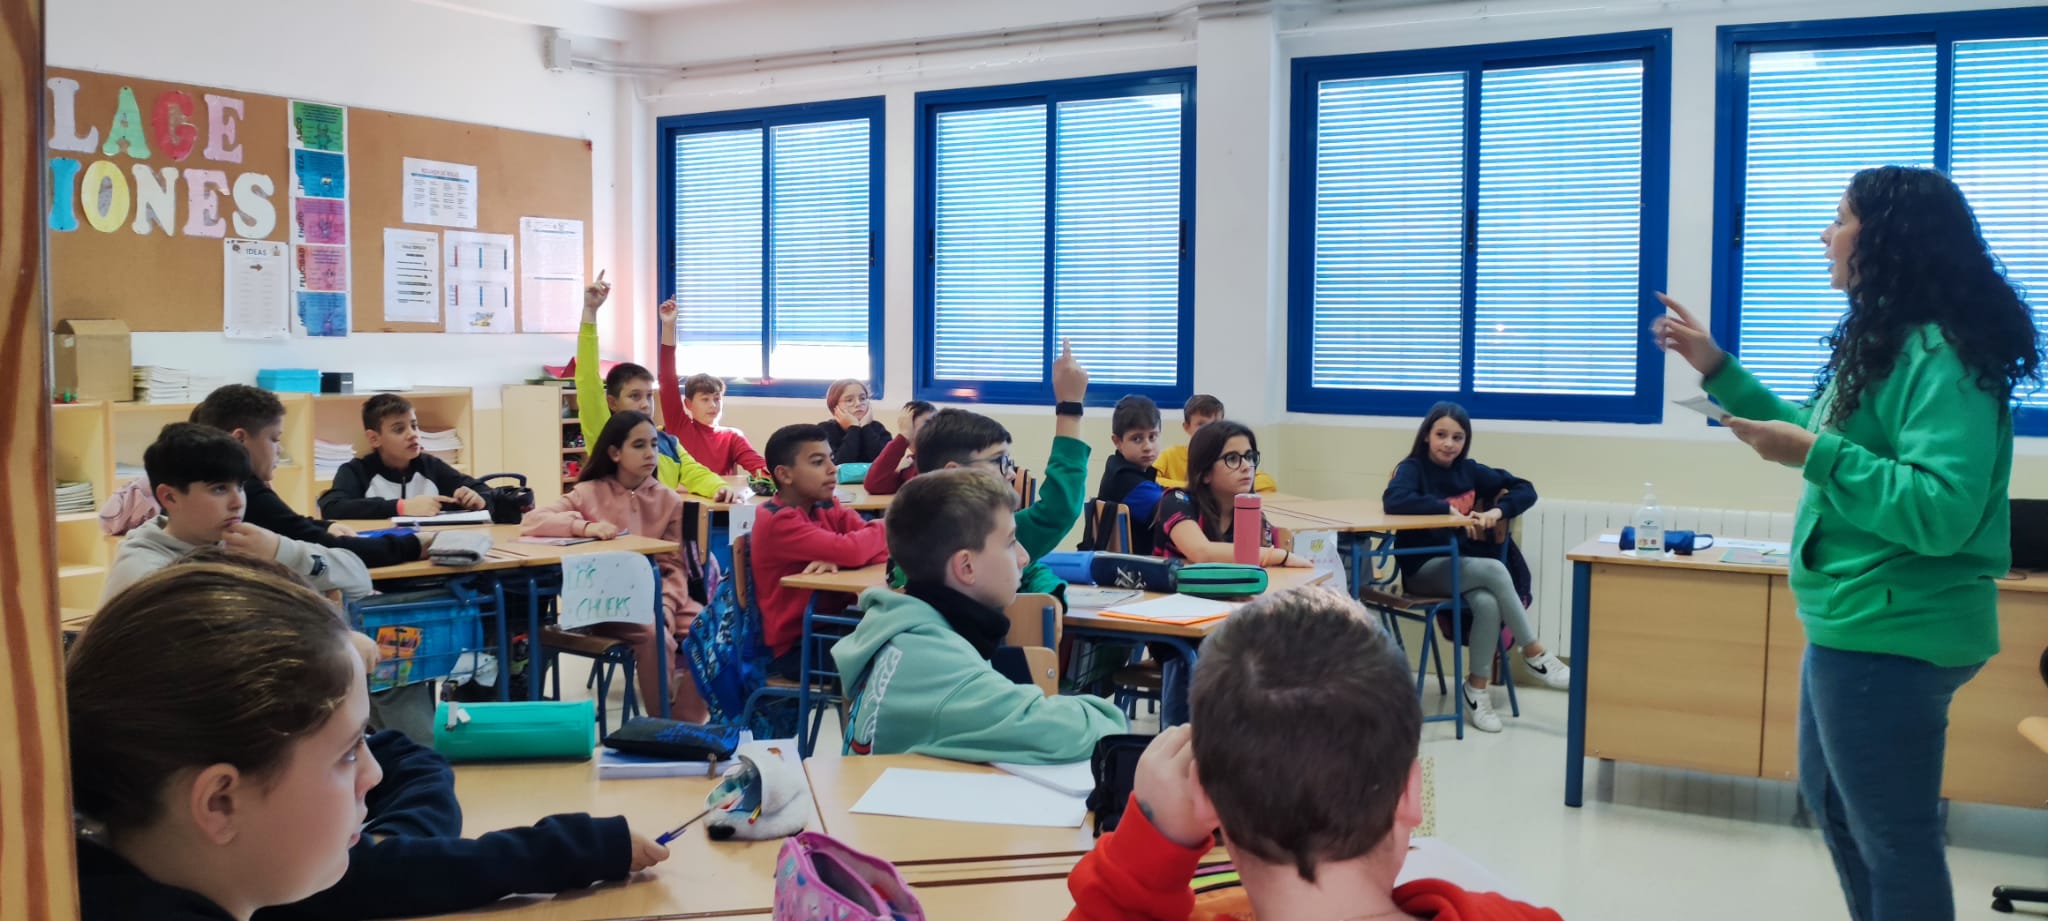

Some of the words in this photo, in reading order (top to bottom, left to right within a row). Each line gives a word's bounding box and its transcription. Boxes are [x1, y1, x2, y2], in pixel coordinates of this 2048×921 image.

[46, 77, 245, 163] LAGE
[47, 156, 276, 239] IONES
[245, 248, 267, 256] IDEAS
[298, 247, 306, 288] FELICIDAD
